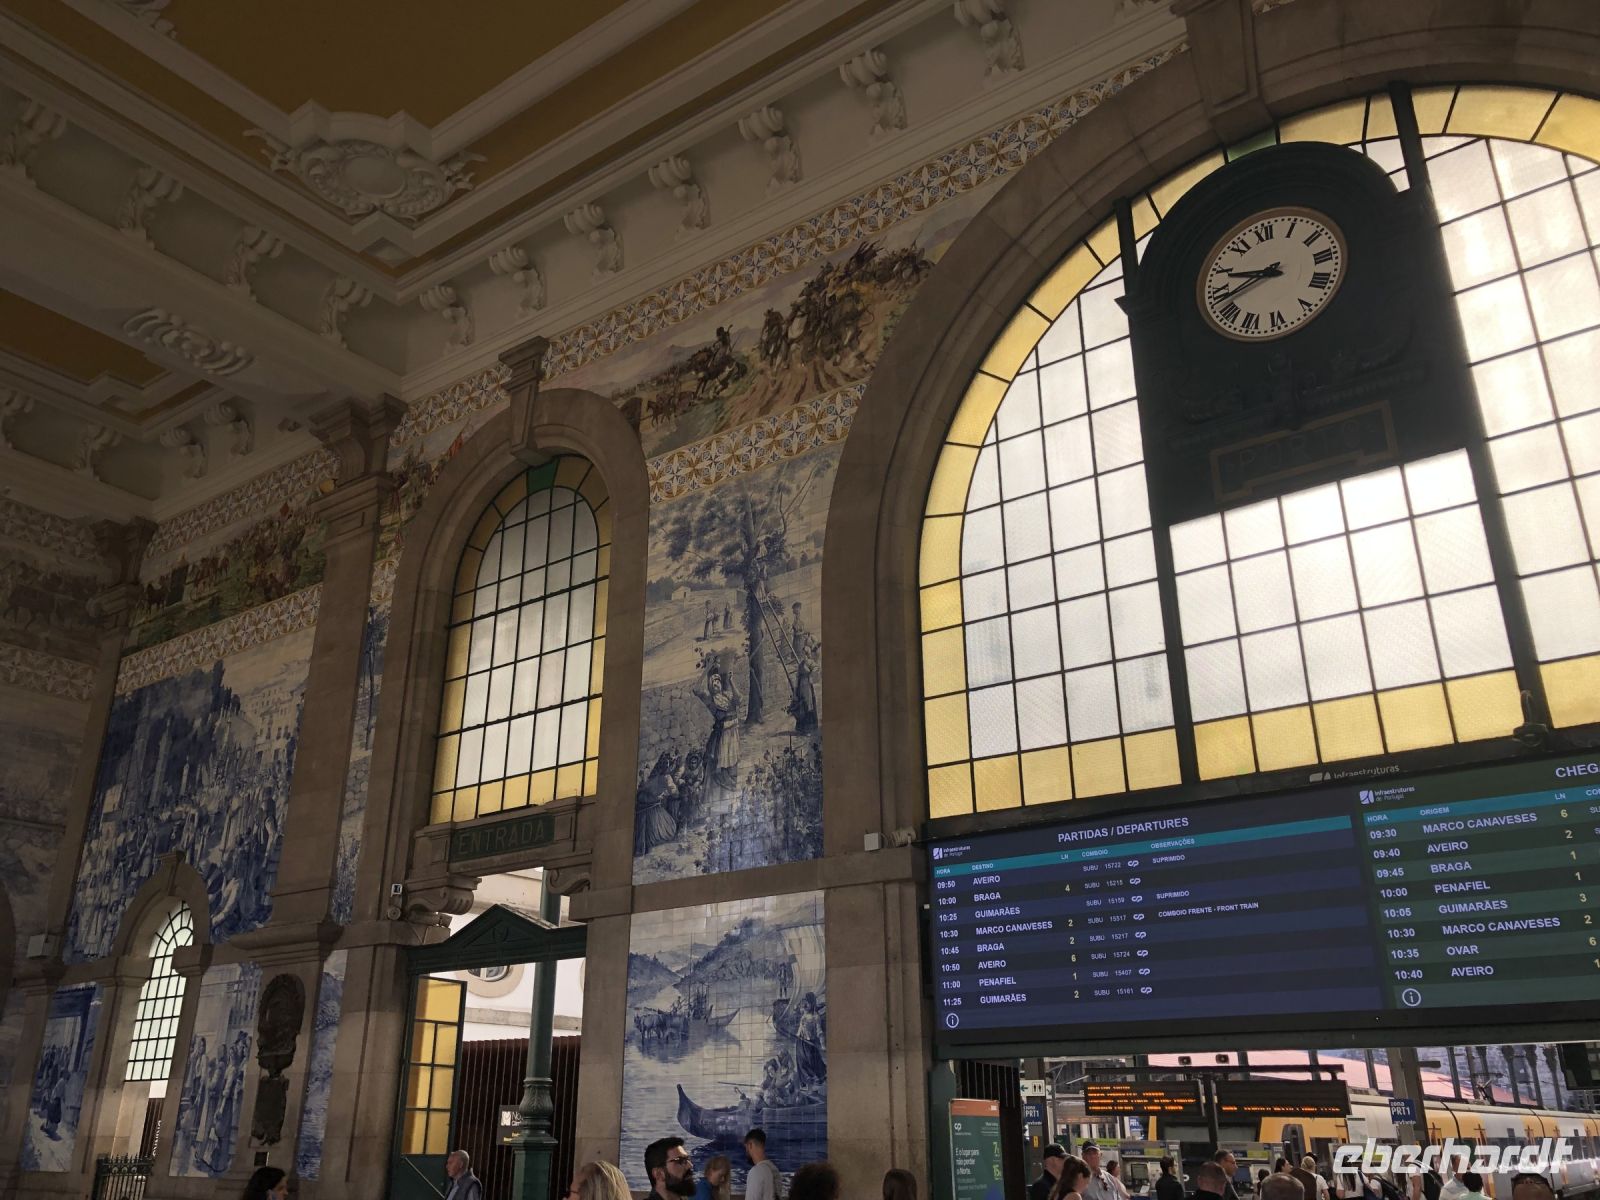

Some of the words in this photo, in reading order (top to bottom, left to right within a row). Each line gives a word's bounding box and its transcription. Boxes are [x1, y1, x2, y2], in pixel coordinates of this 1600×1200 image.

[1254, 224, 1274, 245] XII
[1231, 238, 1252, 257] XI
[1556, 762, 1600, 779] CHEG
[1374, 786, 1415, 797] Infraestruturas
[1367, 814, 1388, 822] HORA
[1420, 806, 1450, 816] ORIGEM
[1370, 828, 1397, 838] 09:30
[1423, 821, 1465, 834] MARCO
[1467, 812, 1538, 828] CANAVESES
[1560, 809, 1568, 818] 6
[458, 820, 545, 854] ENTRADA
[1058, 828, 1109, 842] PARTIDAS
[1110, 827, 1114, 836] /
[1116, 817, 1189, 835] DEPARTURES
[1082, 849, 1108, 858] COMBOIO
[1151, 838, 1195, 849] OBSERVAÇÕES
[1374, 848, 1400, 858] 09:40
[1427, 841, 1469, 854] AVEIRO
[1566, 830, 1573, 839] 2
[938, 880, 956, 889] 09:50
[973, 875, 1000, 885] AVEIRO
[1152, 854, 1185, 863] SUPRIMIDO
[1376, 868, 1404, 878] 09:45
[1431, 861, 1472, 874] BRAGA
[1570, 850, 1577, 860] 1
[1380, 888, 1408, 898] 10:00
[1434, 880, 1490, 893] PENAFIEL
[1575, 871, 1581, 881] 1
[938, 897, 956, 905] 10:00
[974, 892, 1001, 902] BRAGA
[939, 913, 958, 922] 10:25
[975, 906, 1020, 918] GUIMARÃES
[1156, 890, 1189, 899] SUPRIMIDO
[1384, 908, 1412, 918] 10:05
[1438, 899, 1508, 914] GUIMARÃES
[1580, 893, 1587, 902] 3
[940, 930, 958, 938] 10:30
[976, 926, 1004, 935] MARCO
[1006, 921, 1053, 932] CANAVESES
[1158, 910, 1187, 918] COMBOIO
[1188, 907, 1212, 915] FRENTE
[1217, 904, 1238, 912] FRONT
[1387, 928, 1415, 938] 10:30
[1442, 922, 1485, 935] MARCO
[1488, 917, 1560, 932] CANAVESES
[1584, 915, 1592, 924] 2
[941, 947, 959, 955] 10:45
[977, 943, 1005, 952] BRAGA
[1391, 948, 1419, 959] 10:35
[1446, 944, 1479, 956] OVAR
[1589, 936, 1597, 946] 6
[942, 963, 960, 972] 10:50
[978, 960, 1006, 969] AVEIRO
[1395, 969, 1423, 980] 10:40
[1451, 965, 1494, 977] AVEIRO
[1594, 958, 1600, 968] 1
[942, 981, 960, 989] 11:00
[979, 977, 1016, 986] PENAFIEL
[943, 998, 962, 1006] 11:25
[980, 994, 1026, 1004] GUIMARÃES
[1392, 1106, 1410, 1115] PRT1
